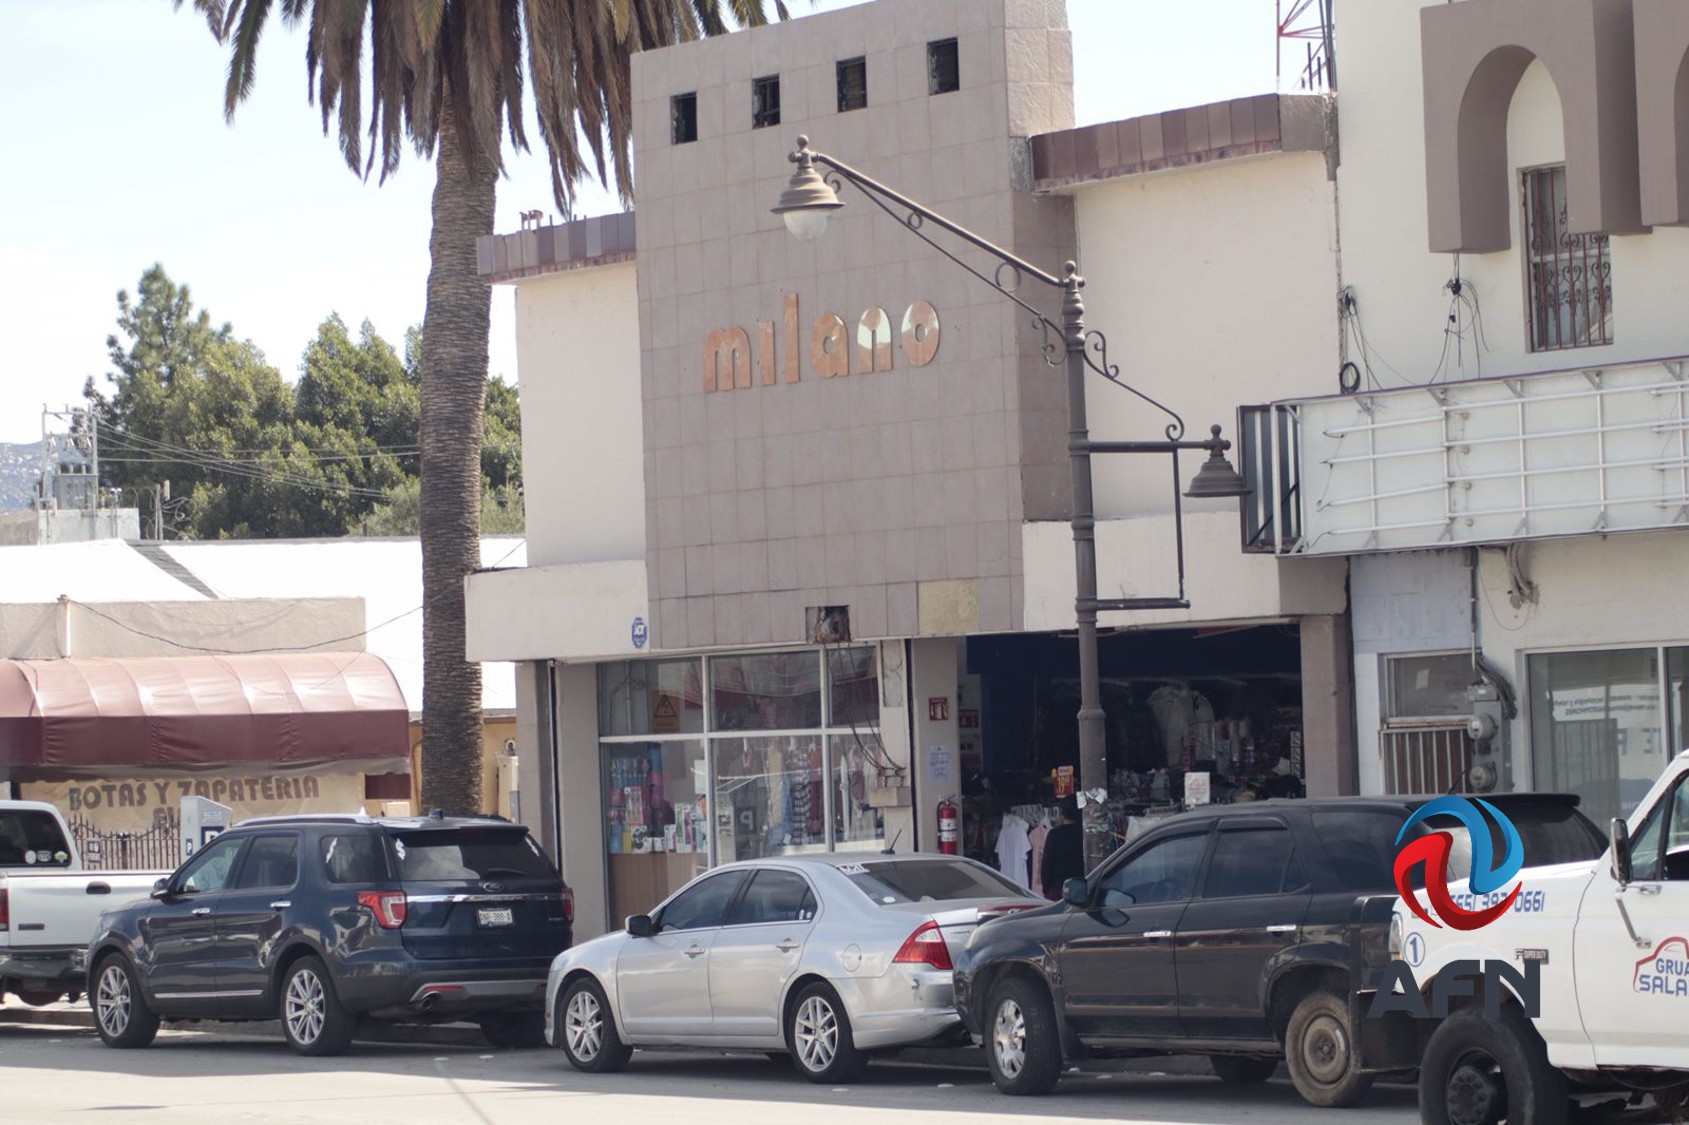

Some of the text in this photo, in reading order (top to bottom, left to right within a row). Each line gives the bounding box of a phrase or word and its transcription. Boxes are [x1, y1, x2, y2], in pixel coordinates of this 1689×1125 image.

[702, 292, 941, 394] milano
[69, 776, 319, 811] BOTAS Y ZAPATERIA
[186, 842, 192, 853] P
[1410, 937, 1419, 963] 1
[1639, 974, 1689, 997] SALA
